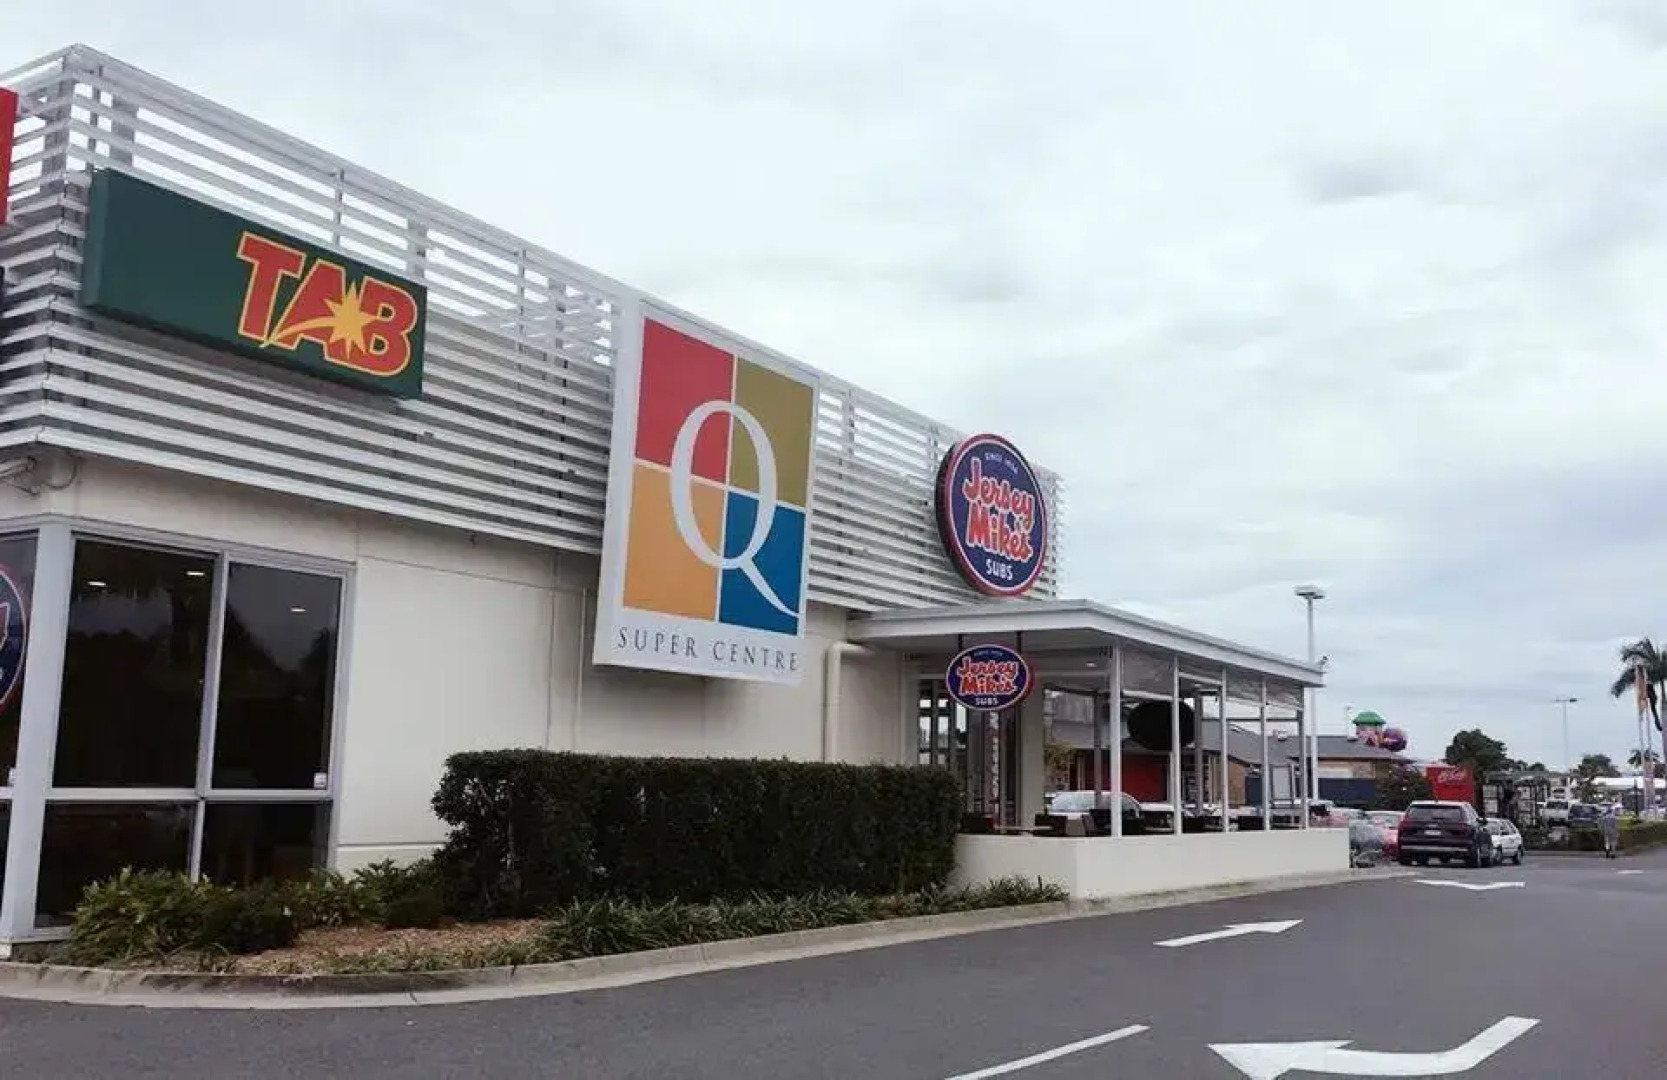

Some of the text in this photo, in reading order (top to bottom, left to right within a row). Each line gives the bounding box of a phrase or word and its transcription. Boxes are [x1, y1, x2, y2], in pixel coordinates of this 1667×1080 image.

[236, 230, 418, 377] TAB
[670, 400, 799, 618] Q
[962, 457, 1035, 531] Jersey
[986, 559, 1013, 580] SUBS
[618, 626, 800, 671] SUPER CENTRE
[956, 656, 1018, 679] Jersey
[975, 697, 998, 706] SUBS
